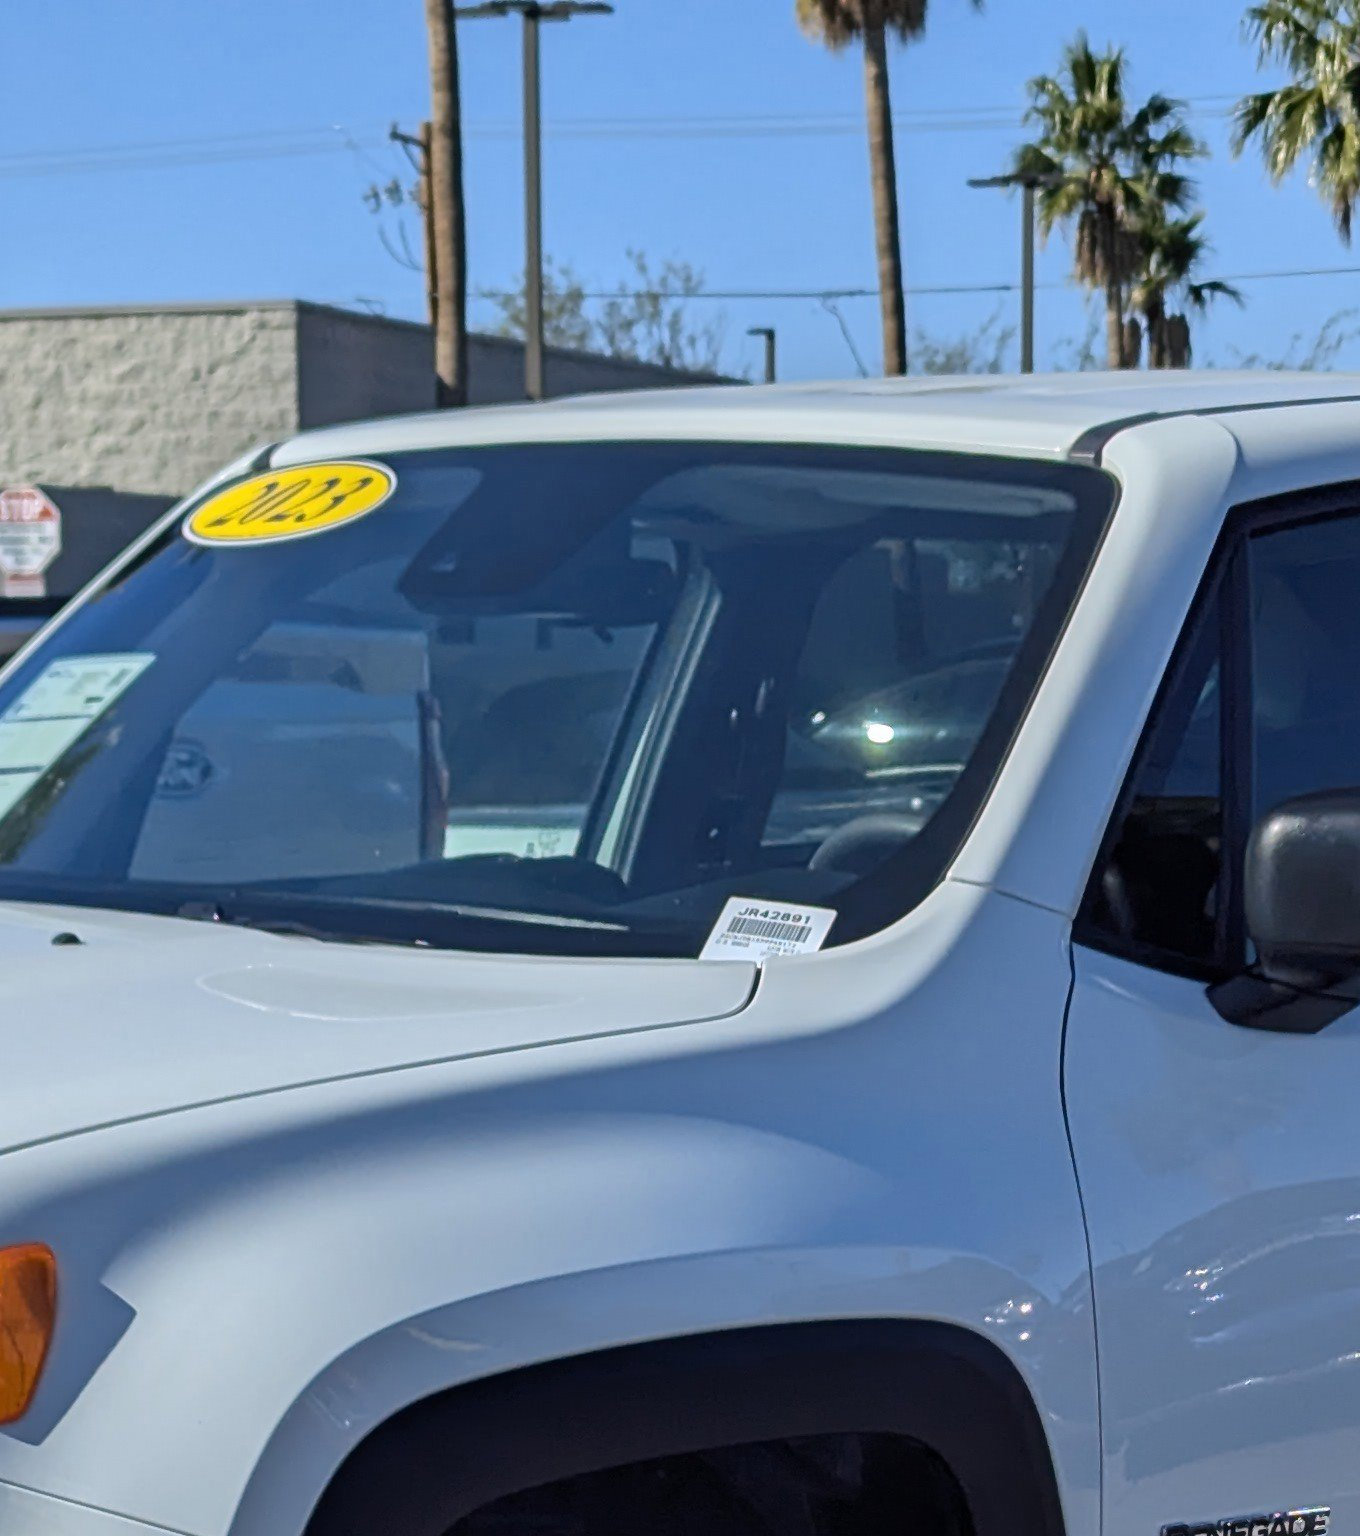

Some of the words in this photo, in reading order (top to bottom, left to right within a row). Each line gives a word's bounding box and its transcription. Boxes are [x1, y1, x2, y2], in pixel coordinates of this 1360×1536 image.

[0, 498, 43, 522] STOP
[204, 477, 374, 528] 2023
[738, 907, 812, 924] JR42891
